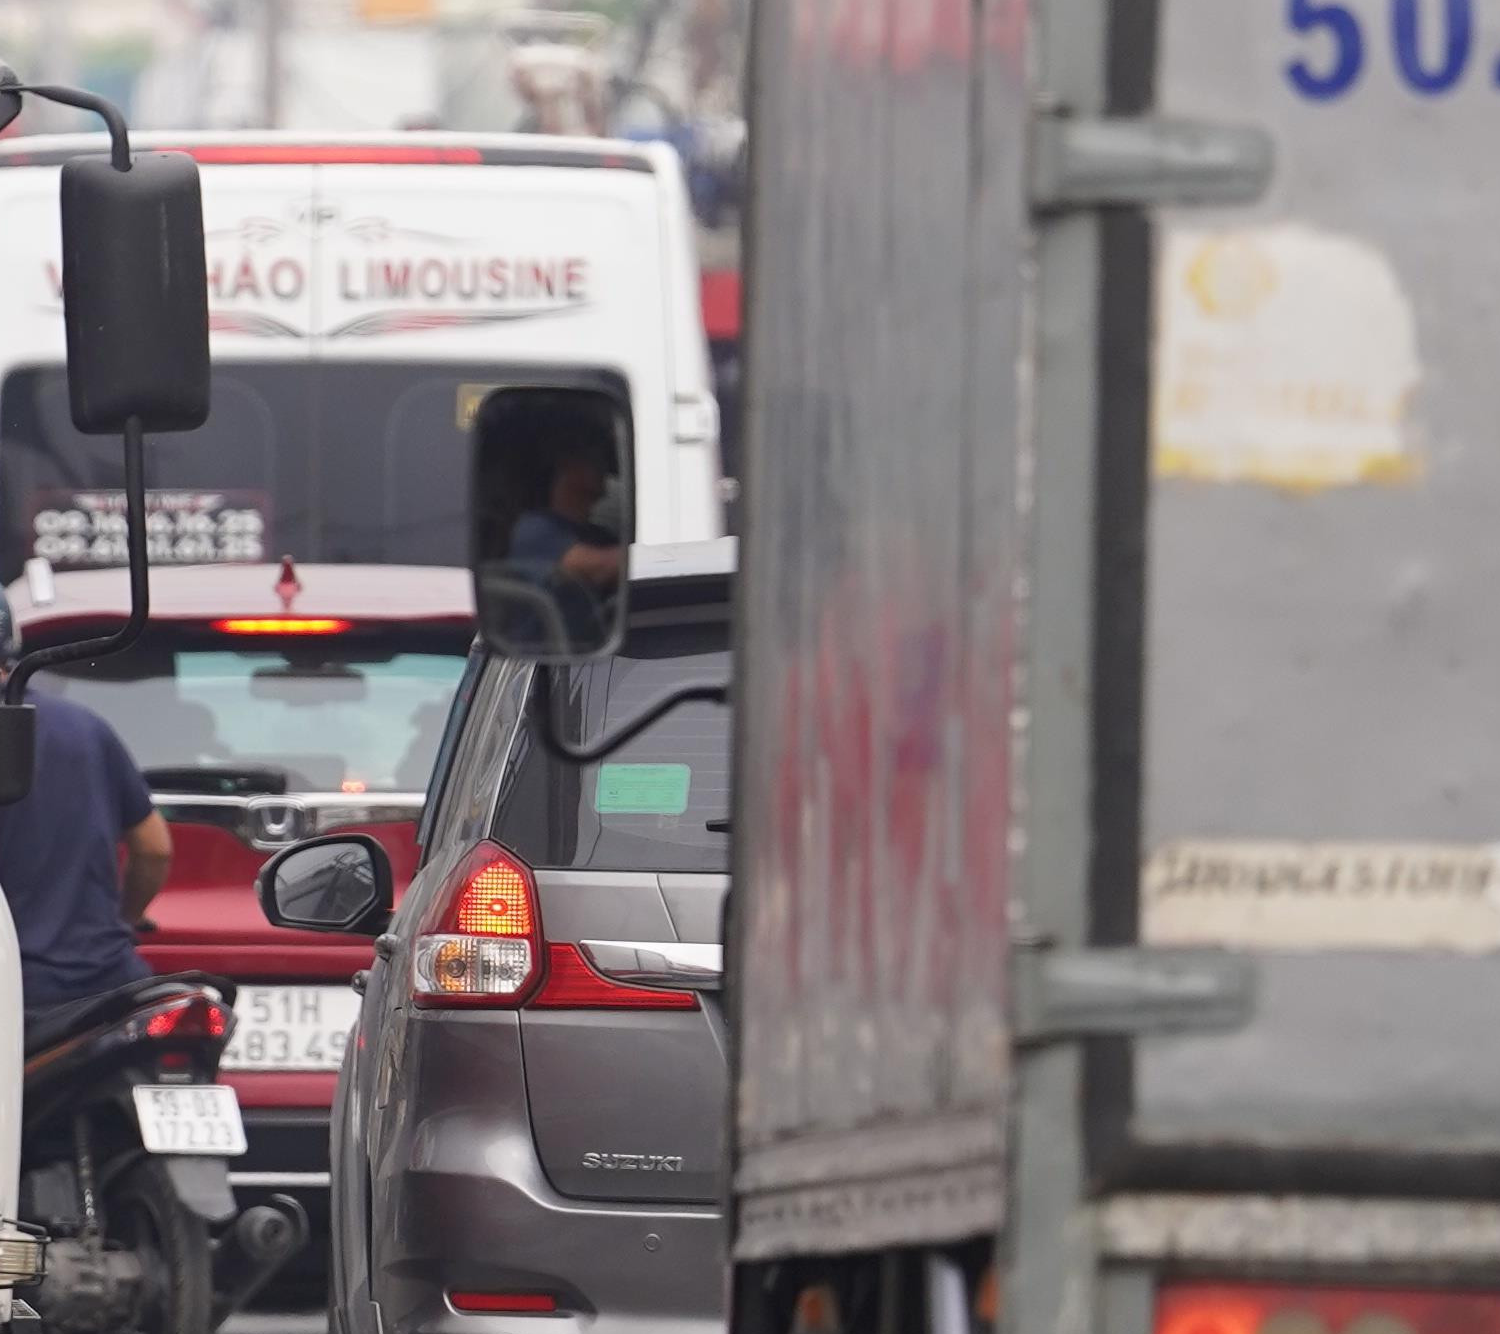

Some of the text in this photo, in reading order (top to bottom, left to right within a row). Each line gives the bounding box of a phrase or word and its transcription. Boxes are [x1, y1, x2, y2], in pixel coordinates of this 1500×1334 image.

[338, 258, 590, 302] LIMOUSINE
[252, 988, 321, 1024] 51H
[582, 1151, 683, 1172] SUZUKI
